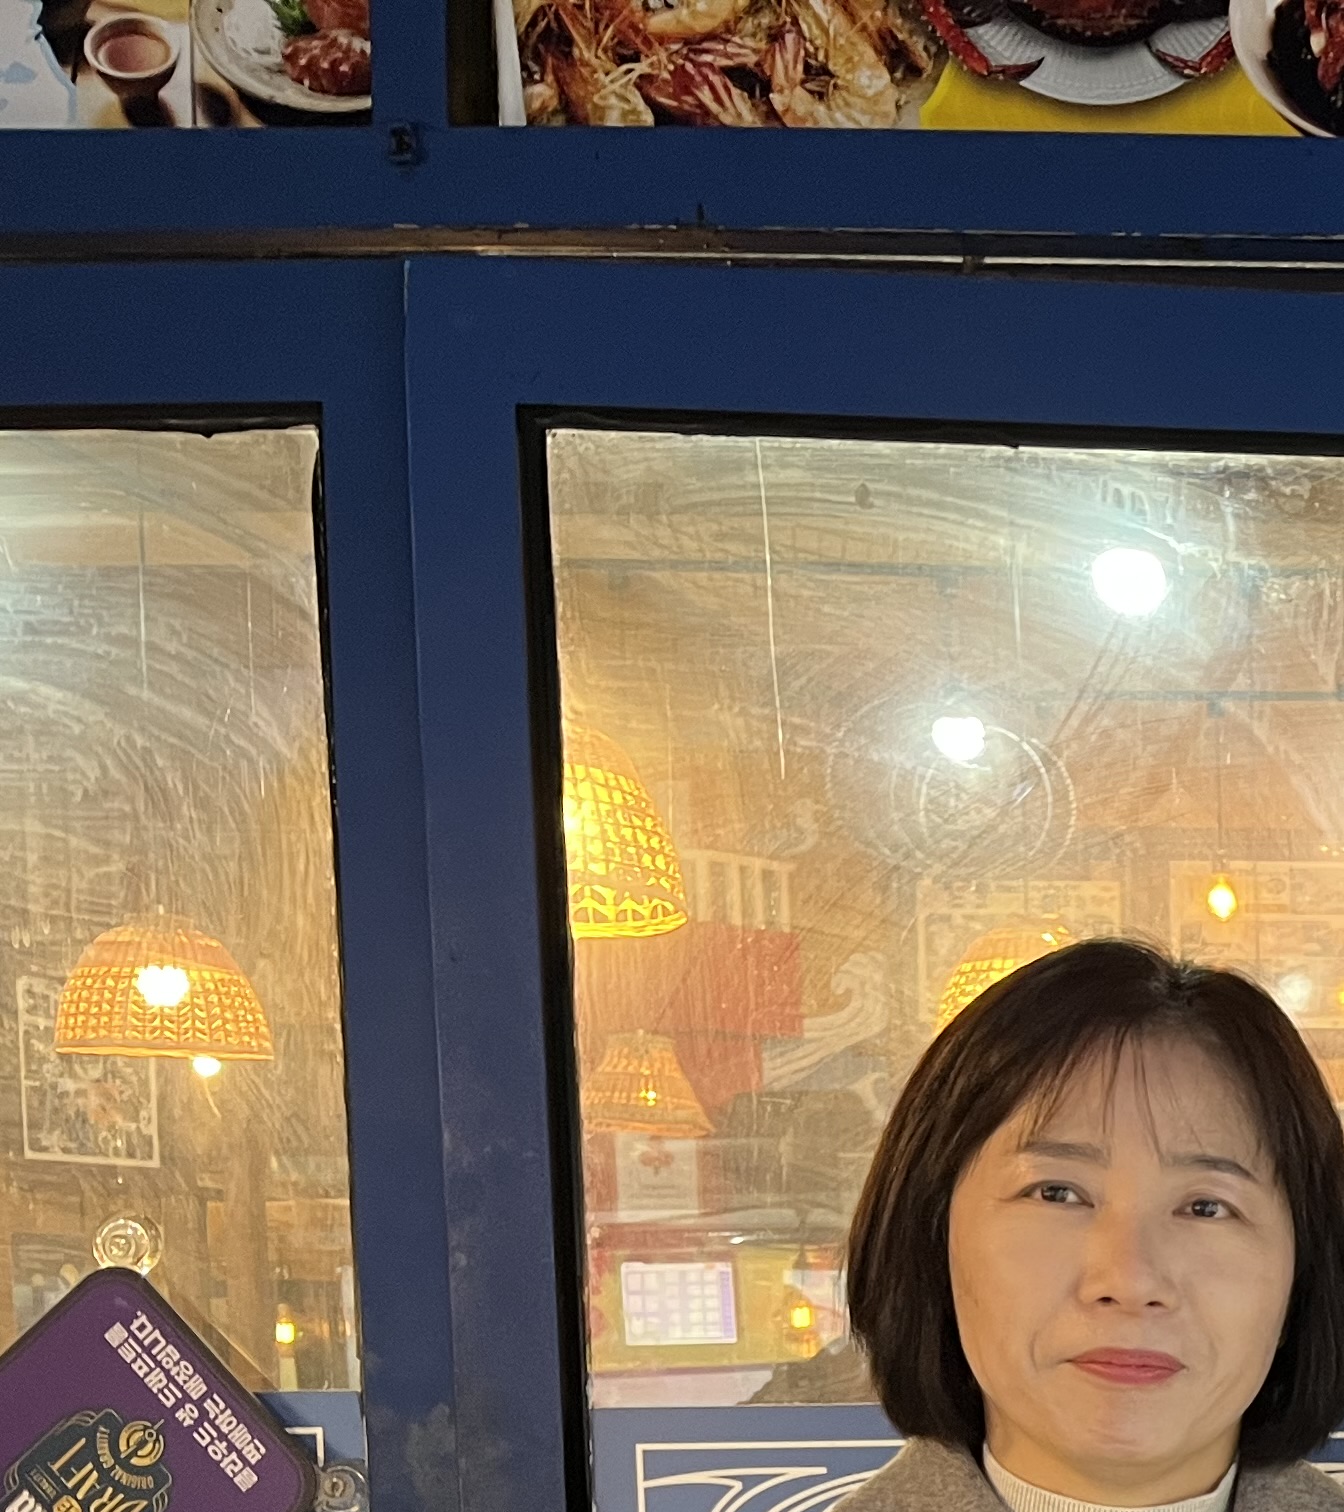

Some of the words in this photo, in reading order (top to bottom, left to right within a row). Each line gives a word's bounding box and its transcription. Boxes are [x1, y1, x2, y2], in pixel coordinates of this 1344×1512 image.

[124, 1309, 212, 1402] 매장입니다.
[173, 1400, 203, 1430] 생
[199, 1392, 269, 1466] 판매하는
[190, 1420, 260, 1494] 클라우드
